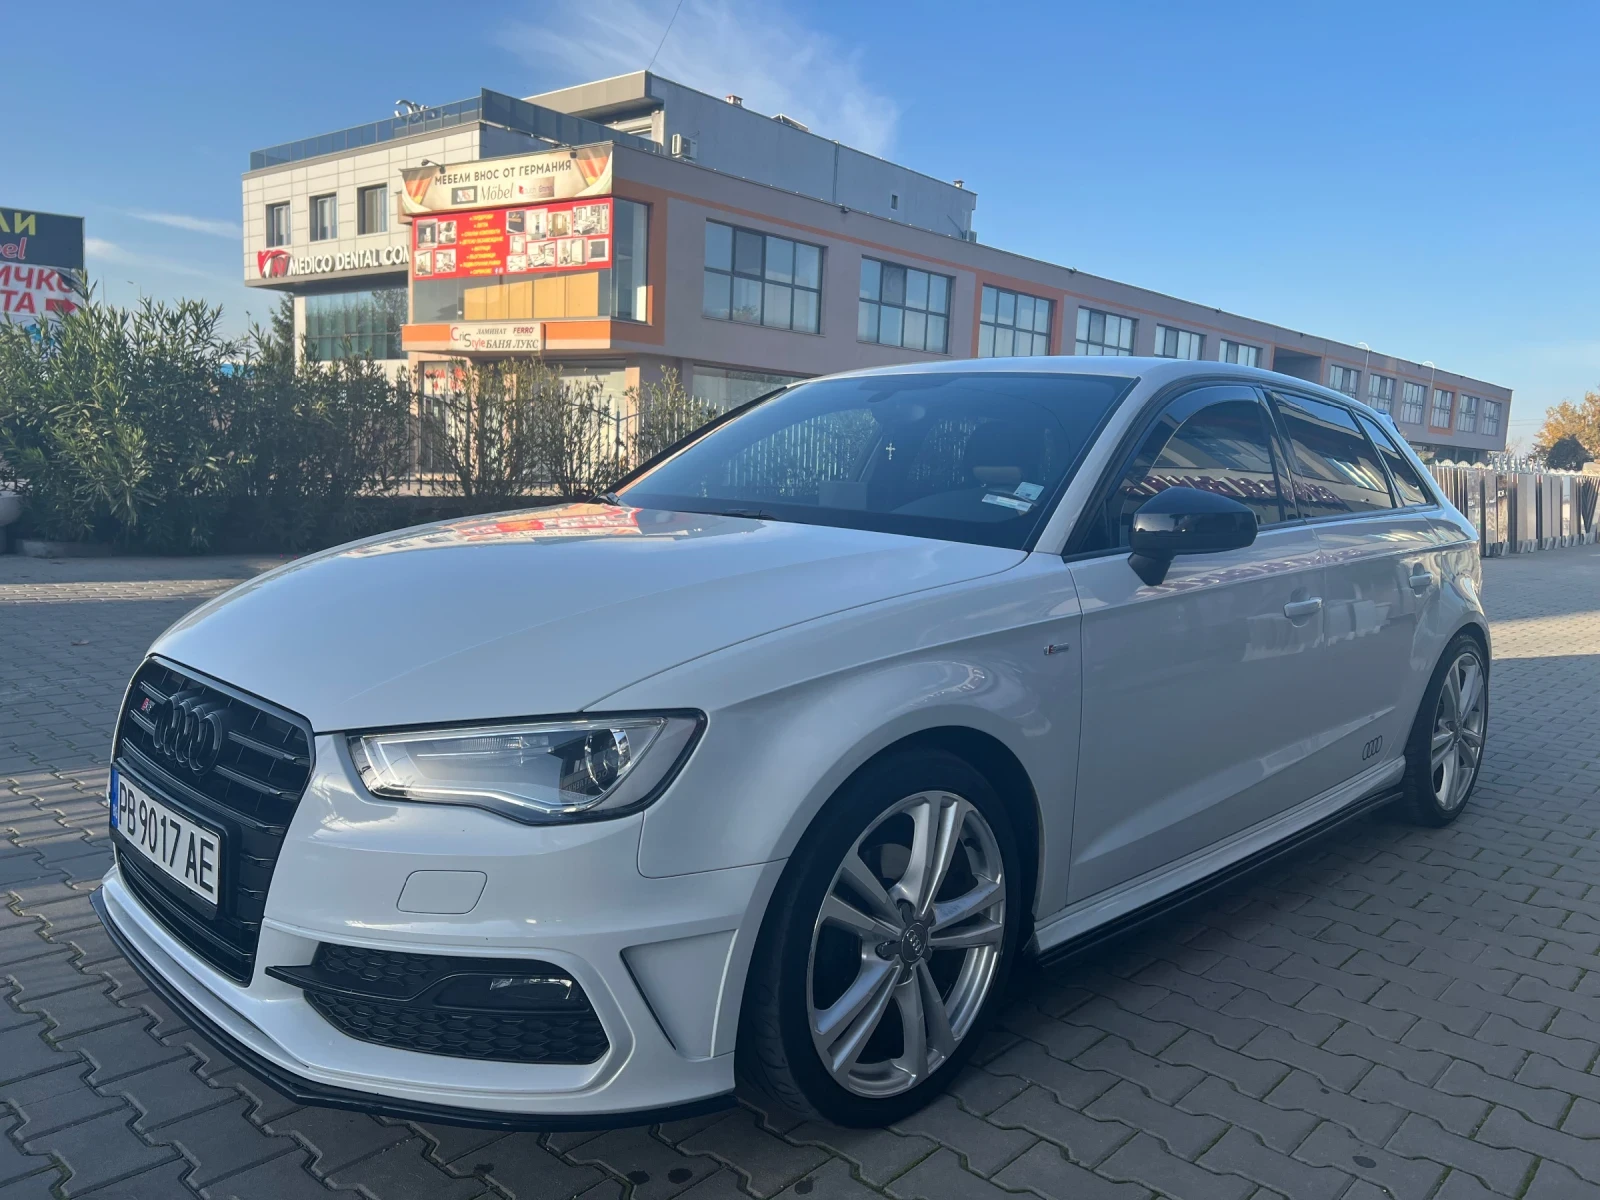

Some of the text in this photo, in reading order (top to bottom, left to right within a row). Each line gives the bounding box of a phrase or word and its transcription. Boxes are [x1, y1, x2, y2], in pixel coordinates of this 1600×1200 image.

[435, 160, 572, 185] МЕБЕЛИ ВНОС ОТ ГЕРМАНИЯ
[481, 183, 514, 200] Möbel
[0, 237, 27, 259] el
[288, 254, 333, 276] MEDICO
[335, 249, 379, 271] DENTAL
[476, 327, 507, 335] ЛАМИНАТ
[513, 326, 534, 334] FERRO
[486, 339, 538, 349] БАНЯ ЛУКС
